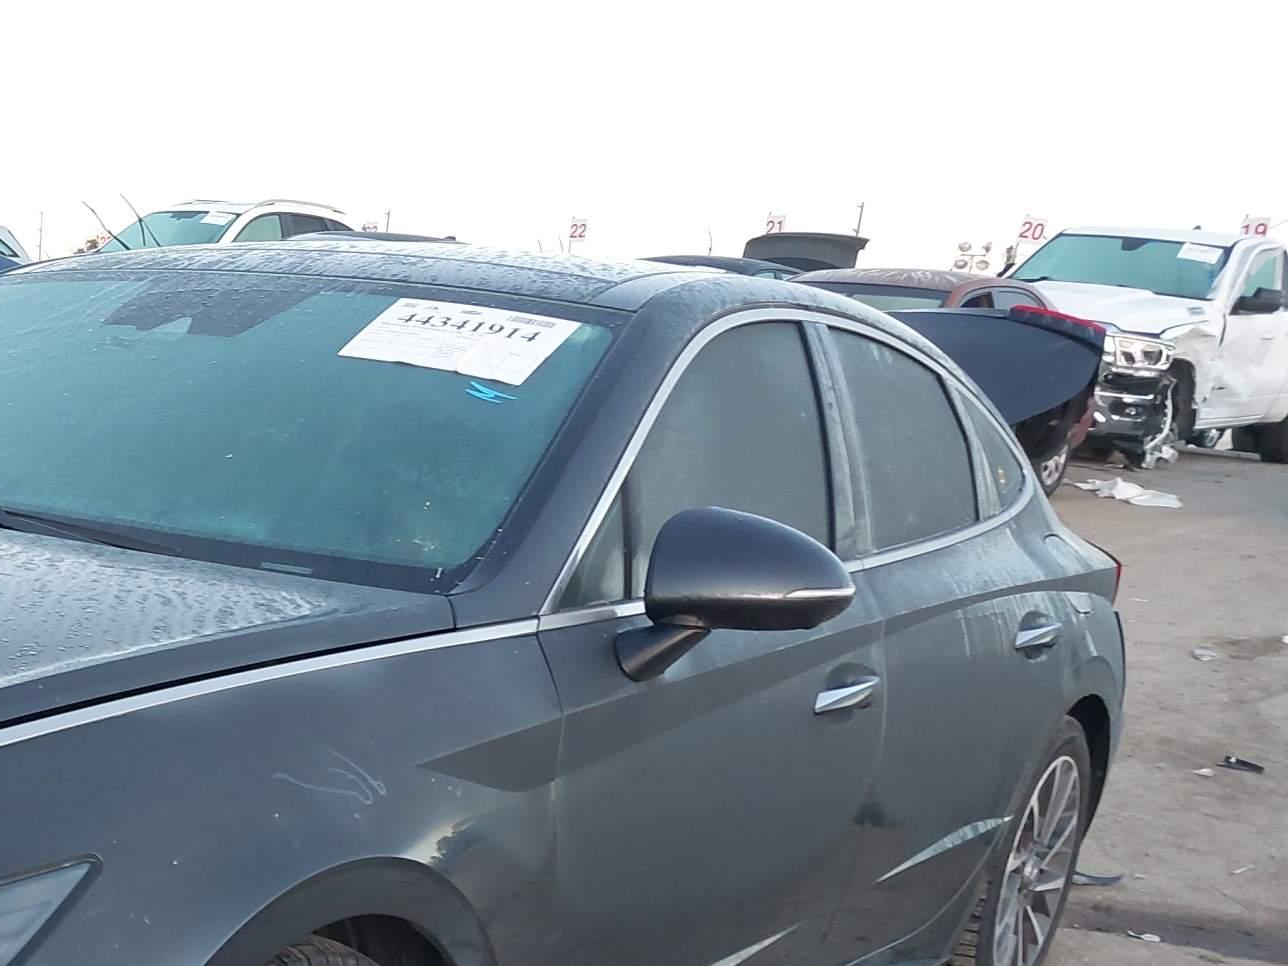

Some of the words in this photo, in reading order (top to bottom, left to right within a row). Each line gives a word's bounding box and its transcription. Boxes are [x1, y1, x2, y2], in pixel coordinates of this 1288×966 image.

[569, 223, 587, 239] 22
[1019, 221, 1045, 241] 20
[397, 312, 542, 343] 44341914
